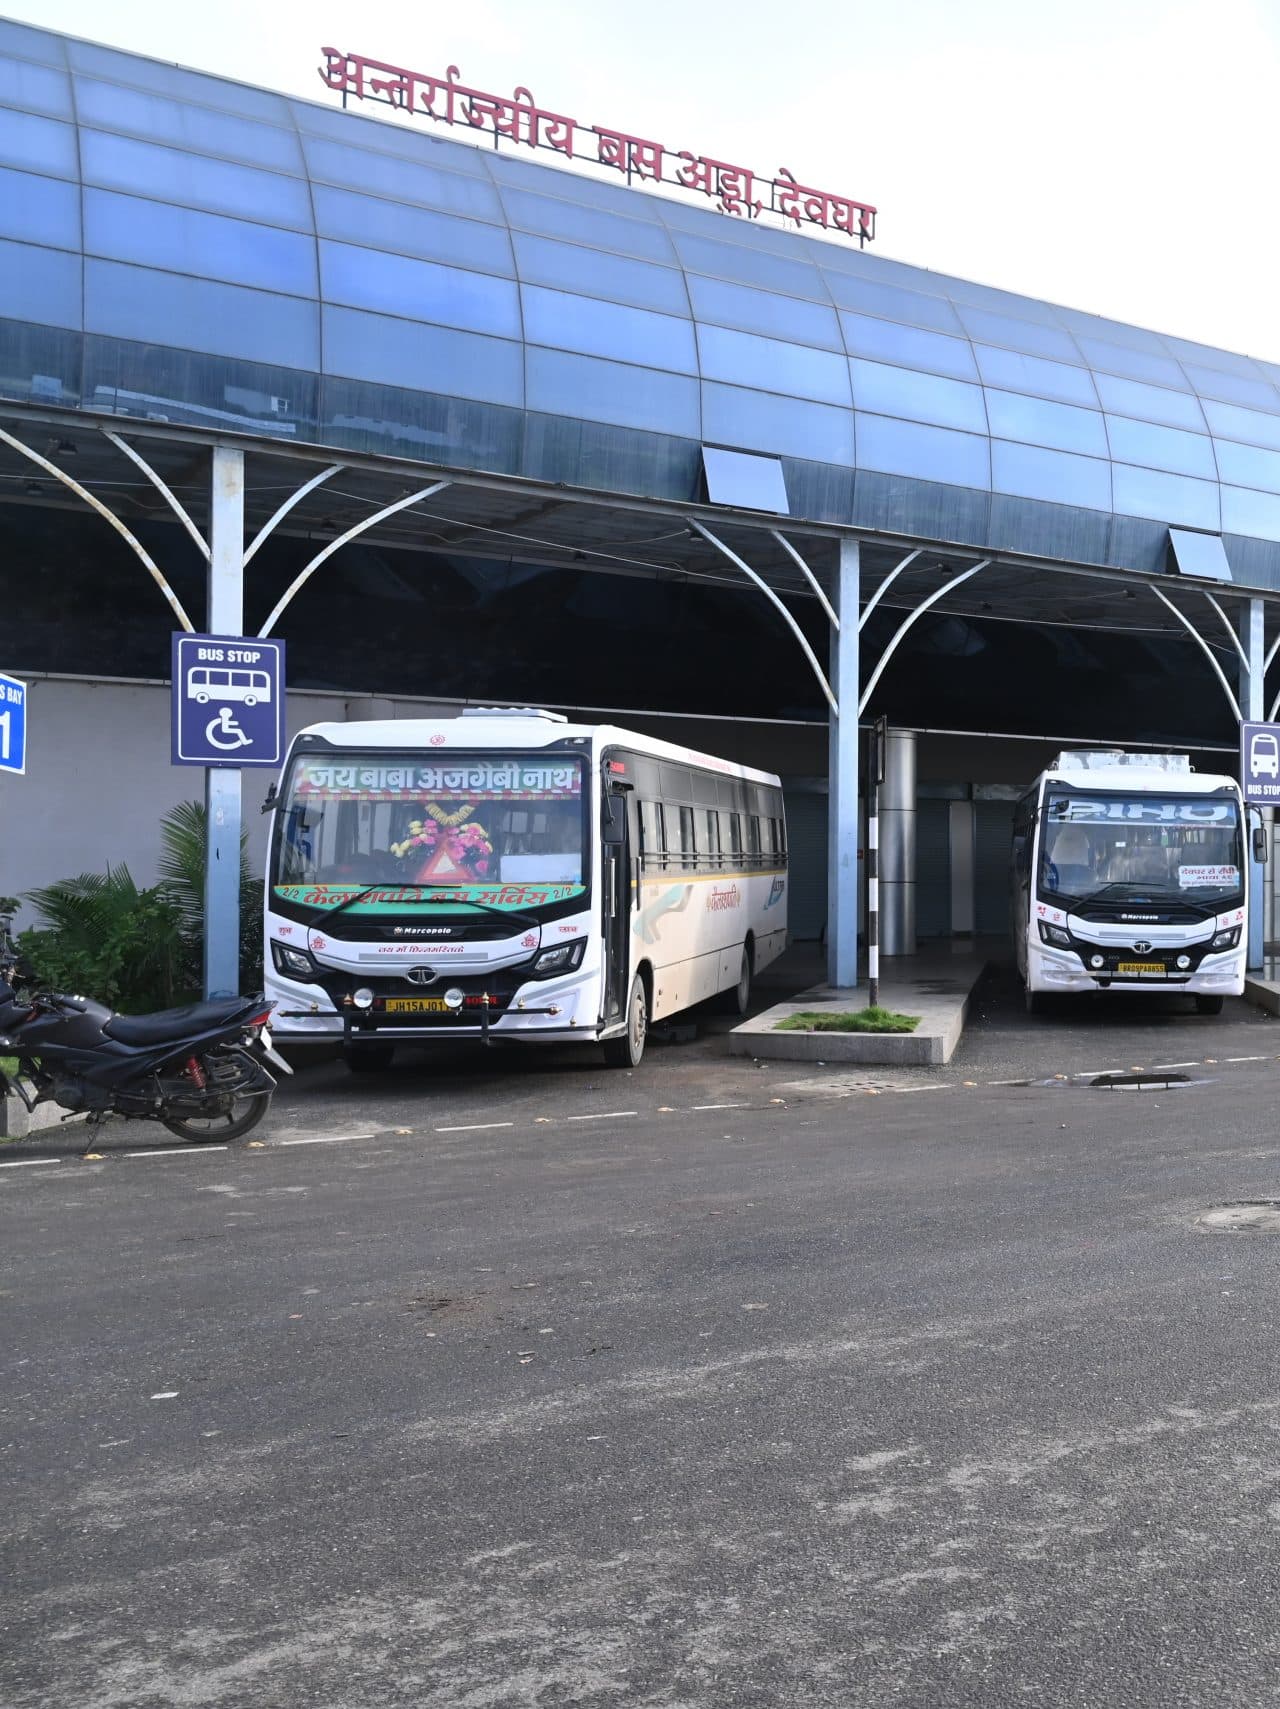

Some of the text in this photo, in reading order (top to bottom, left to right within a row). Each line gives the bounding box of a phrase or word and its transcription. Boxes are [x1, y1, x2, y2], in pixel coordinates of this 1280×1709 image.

[591, 125, 665, 182] बस
[773, 166, 878, 242] देवघर
[198, 648, 261, 664] BUS STOP
[7, 686, 23, 705] BAY
[308, 766, 358, 789] जय
[359, 766, 413, 789] बाबा
[522, 767, 574, 790] नाथ
[1247, 784, 1262, 795] BUS
[1057, 801, 1229, 821] PIHU
[282, 888, 299, 899] 2/2
[475, 886, 549, 905] सर्विस
[553, 888, 572, 899] 2/2
[393, 1001, 453, 1012] JH15AJ01
